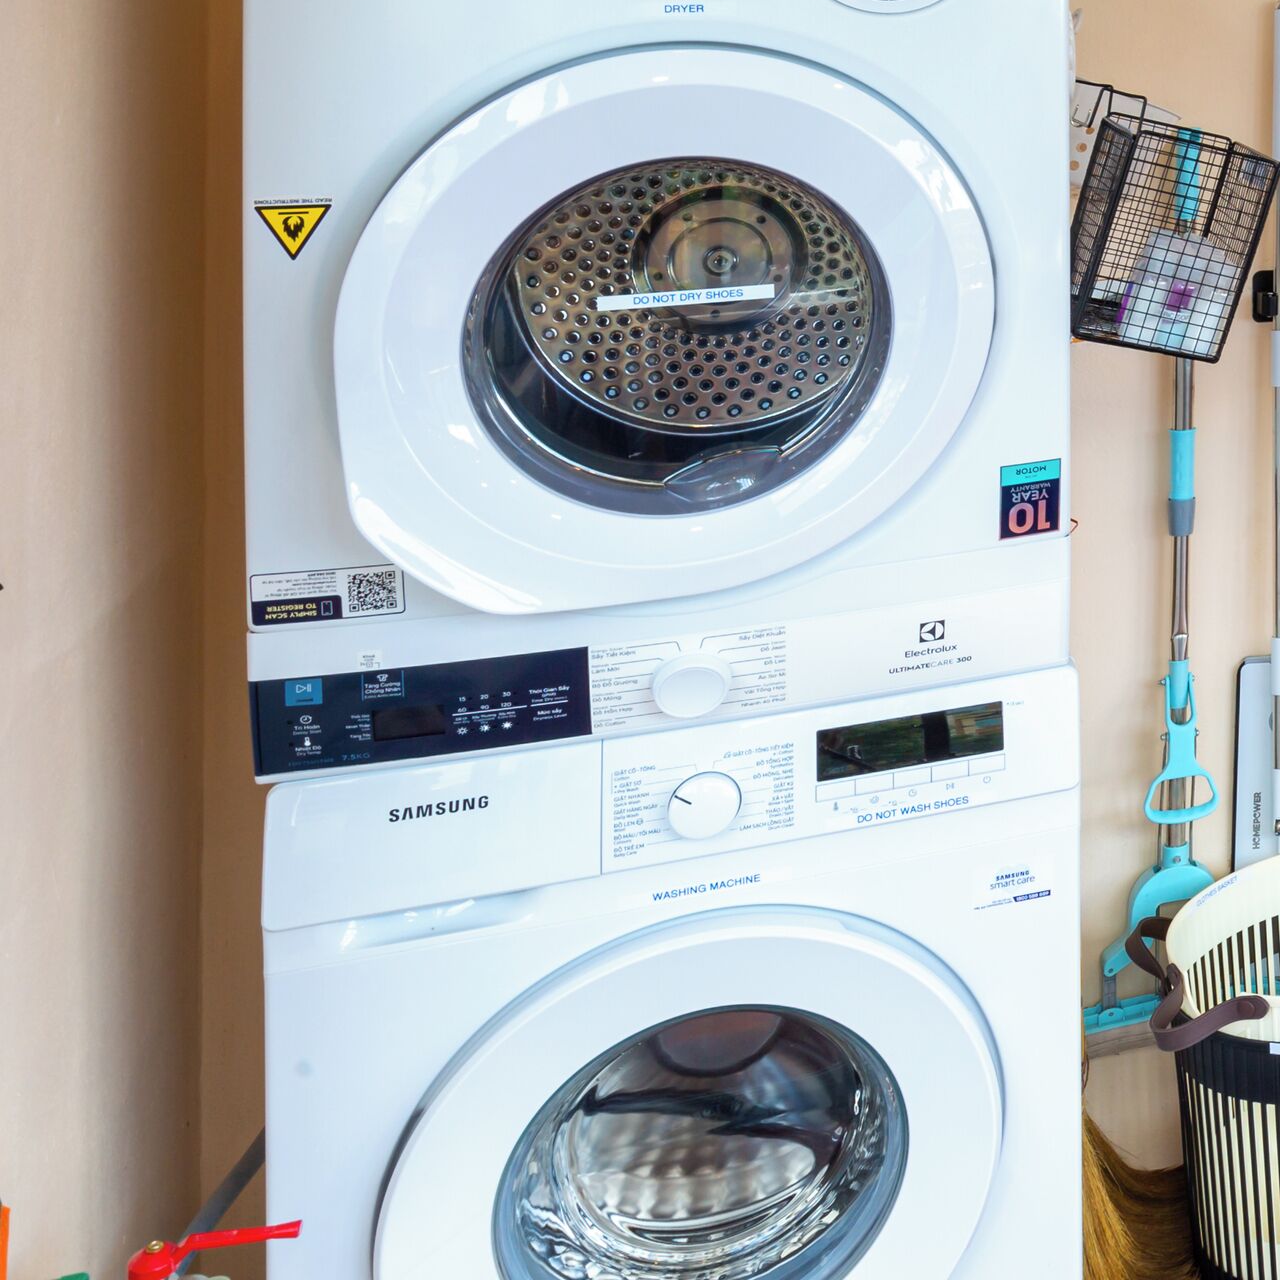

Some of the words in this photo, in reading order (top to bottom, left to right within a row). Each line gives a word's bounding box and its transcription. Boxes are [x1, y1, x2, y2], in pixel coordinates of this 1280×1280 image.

[664, 4, 705, 14] DRYER
[633, 295, 652, 305] DO
[653, 293, 676, 304] NOT
[679, 291, 702, 301] DRY
[705, 288, 744, 300] SHOES
[1016, 465, 1047, 475] MOTOR
[1010, 482, 1051, 493] WARRANTY
[1012, 489, 1049, 503] YEAR
[1008, 500, 1051, 534] 10
[266, 604, 305, 612] REGISTER
[289, 610, 317, 619] SIMPLY
[265, 612, 288, 620] SCAN
[904, 644, 958, 658] Electrolux
[956, 655, 972, 663] 300
[389, 795, 489, 822] SAMSUNG
[857, 813, 873, 823] DO
[875, 809, 897, 820] NOT
[900, 803, 931, 815] WASH
[933, 796, 969, 810] SHOES
[1252, 792, 1261, 849] HOMEPOWER
[996, 870, 1029, 881] SAMSUNG
[652, 884, 707, 901] WASHING
[709, 873, 761, 891] MACHINE
[990, 879, 1015, 890] smart
[1016, 876, 1035, 885] care
